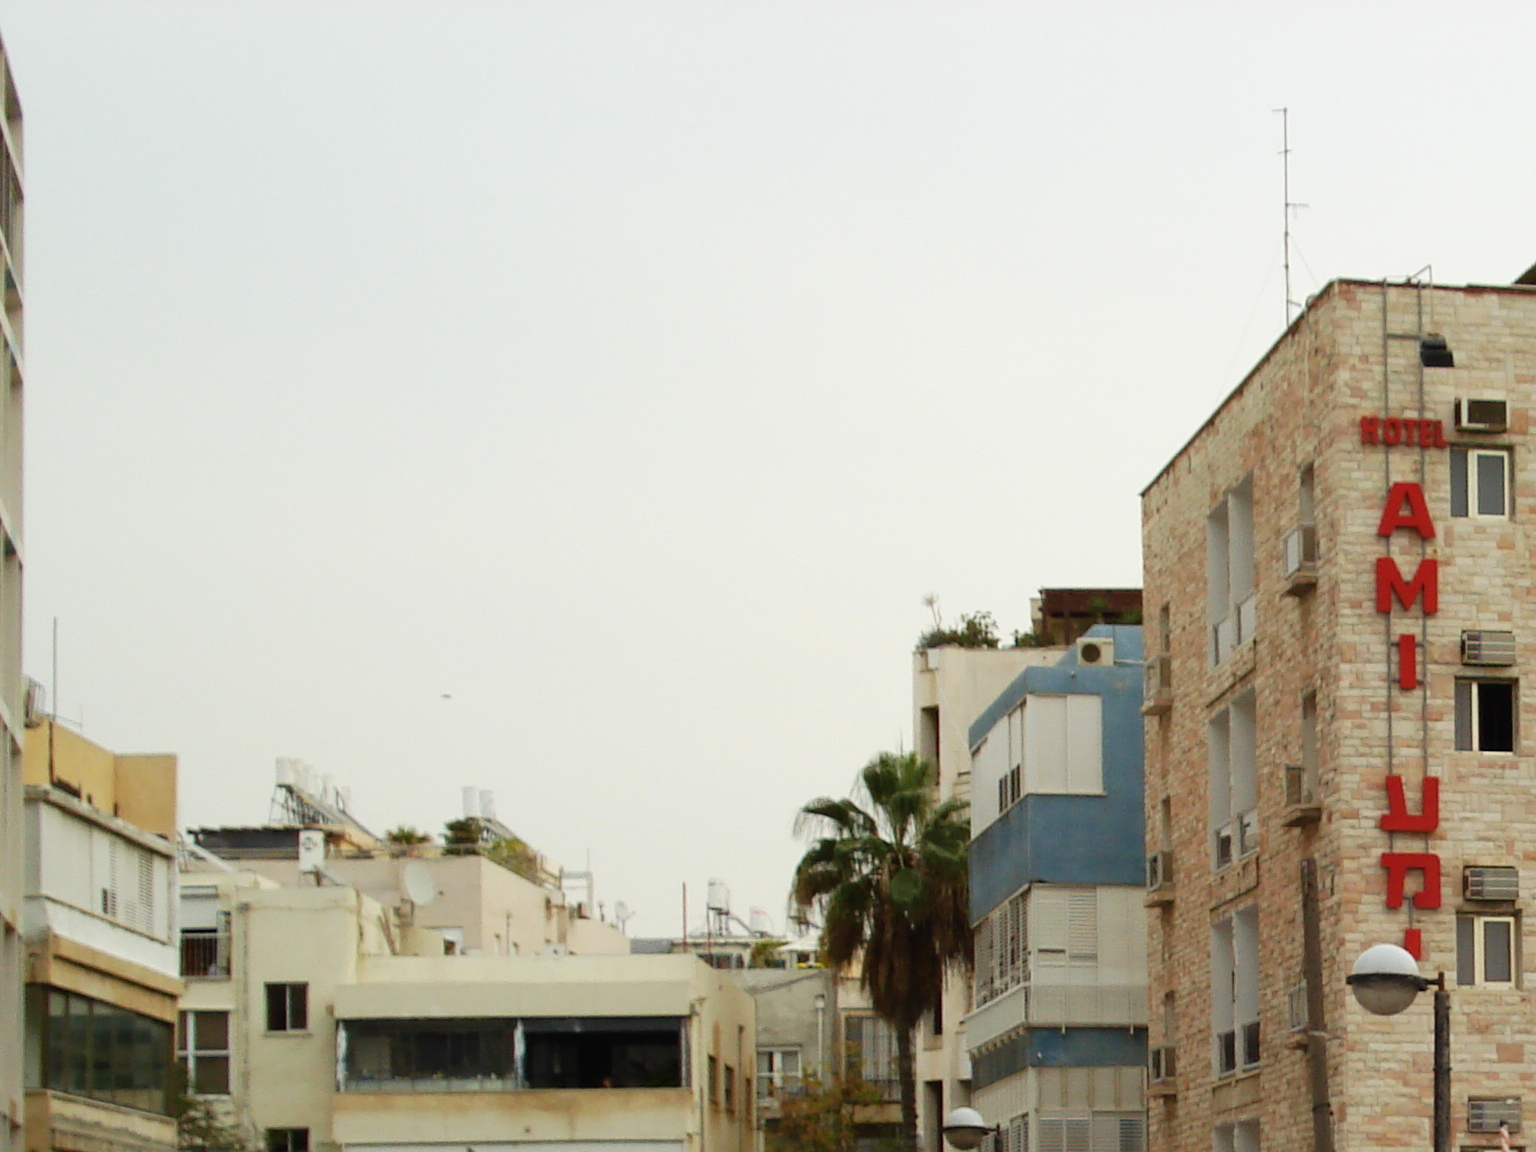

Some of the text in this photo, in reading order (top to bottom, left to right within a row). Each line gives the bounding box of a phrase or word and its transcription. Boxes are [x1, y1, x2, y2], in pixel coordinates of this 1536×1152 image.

[1360, 415, 1448, 448] HOTEL
[1374, 481, 1440, 690] AMI
[1379, 774, 1442, 961] עמי
